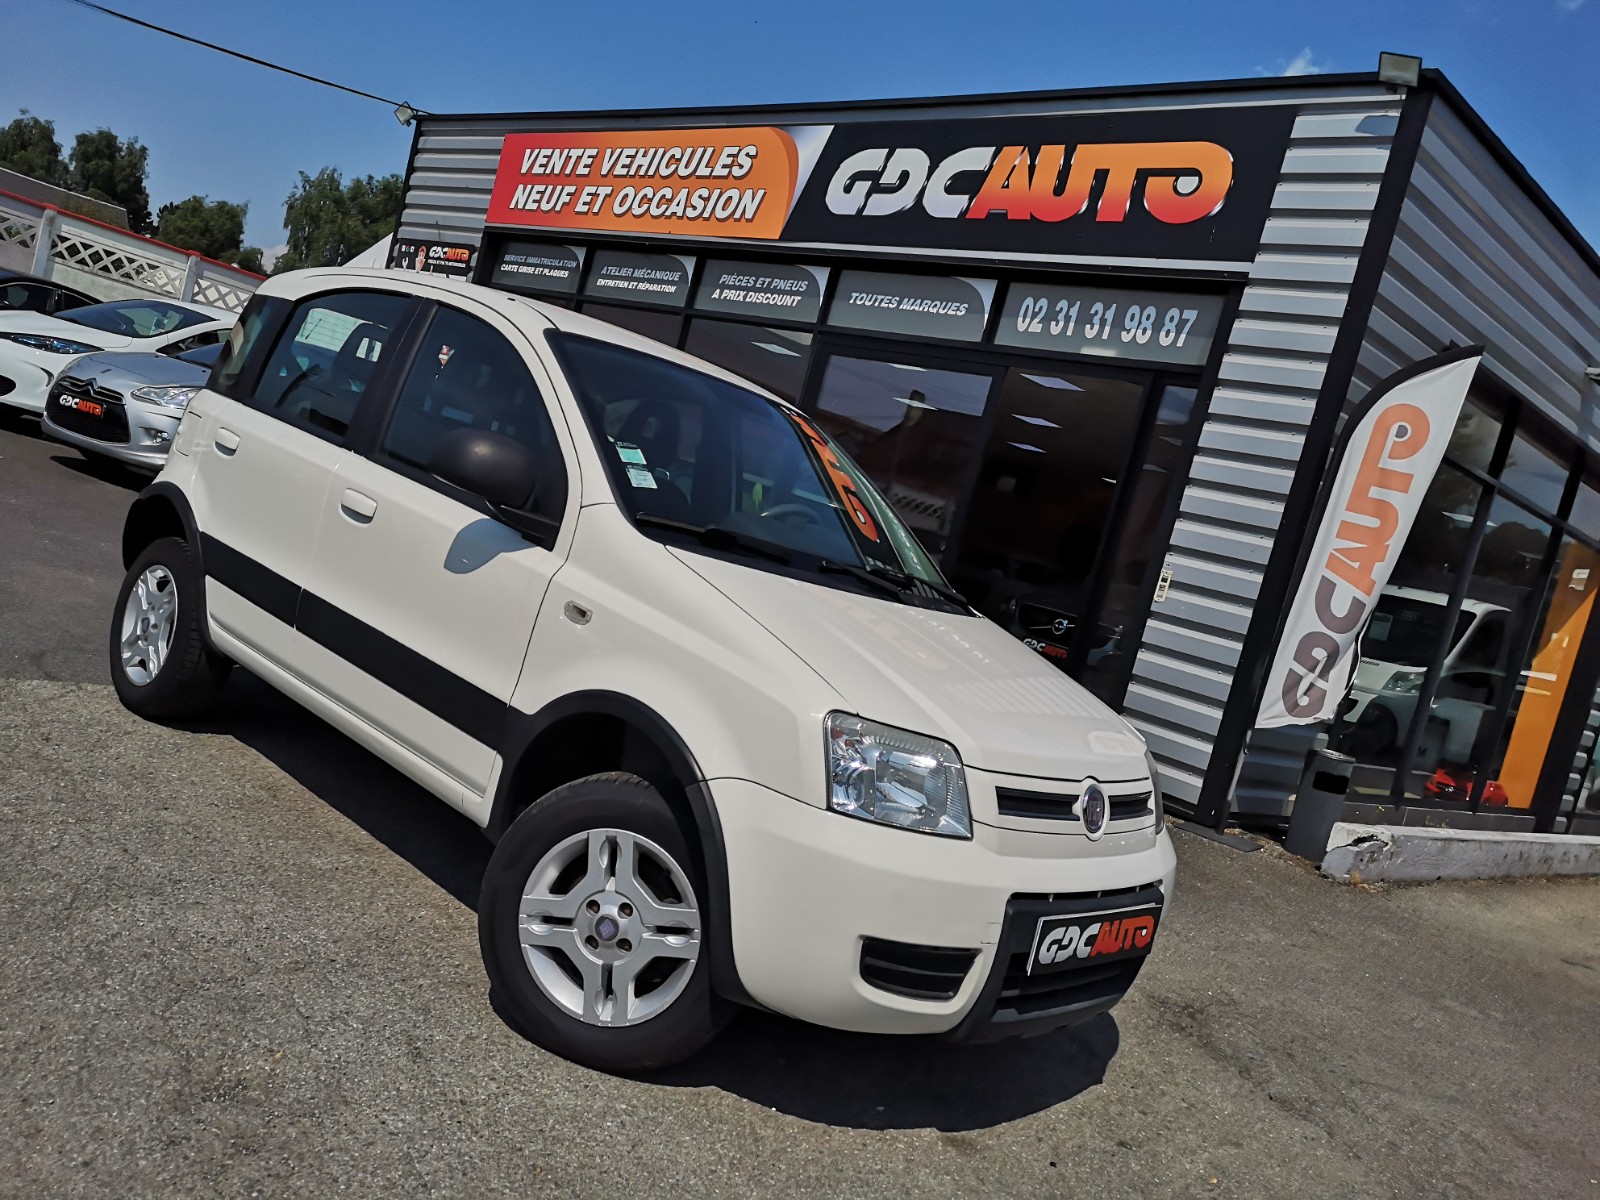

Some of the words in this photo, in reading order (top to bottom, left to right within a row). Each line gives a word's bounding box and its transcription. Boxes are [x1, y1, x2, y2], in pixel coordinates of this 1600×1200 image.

[520, 148, 598, 176] VENTE
[600, 145, 758, 178] VEHICULES
[825, 140, 1234, 225] GDCAUTO
[509, 184, 577, 212] NEUF
[574, 186, 613, 214] ET
[612, 186, 766, 221] OCCASION
[500, 263, 519, 272] CARTE
[518, 265, 535, 274] GRISE
[534, 267, 543, 275] ET
[542, 268, 570, 278] PLAQUES
[503, 254, 526, 263] SERVICE
[526, 256, 578, 268] IMMATRICULATION
[601, 266, 634, 277] ATELIER
[632, 267, 681, 281] MÉCANIQUE
[719, 272, 756, 287] PIÈCES
[755, 277, 771, 288] ET
[770, 278, 808, 292] PNEUS
[596, 278, 629, 288] ENTRETIEN
[627, 281, 638, 289] ET
[636, 281, 677, 293] RÉPARATION
[711, 288, 720, 299] A
[720, 289, 747, 302] PRIX
[745, 291, 802, 307] DISCOUNT
[849, 292, 900, 308] TOUTES
[899, 297, 969, 316] MARQUES
[1016, 296, 1048, 333] 02
[1050, 299, 1081, 336] 31
[1084, 302, 1117, 340] 31
[1120, 304, 1157, 344] 98
[1158, 307, 1198, 347] 87
[1038, 915, 1155, 965] GDCAUTO
